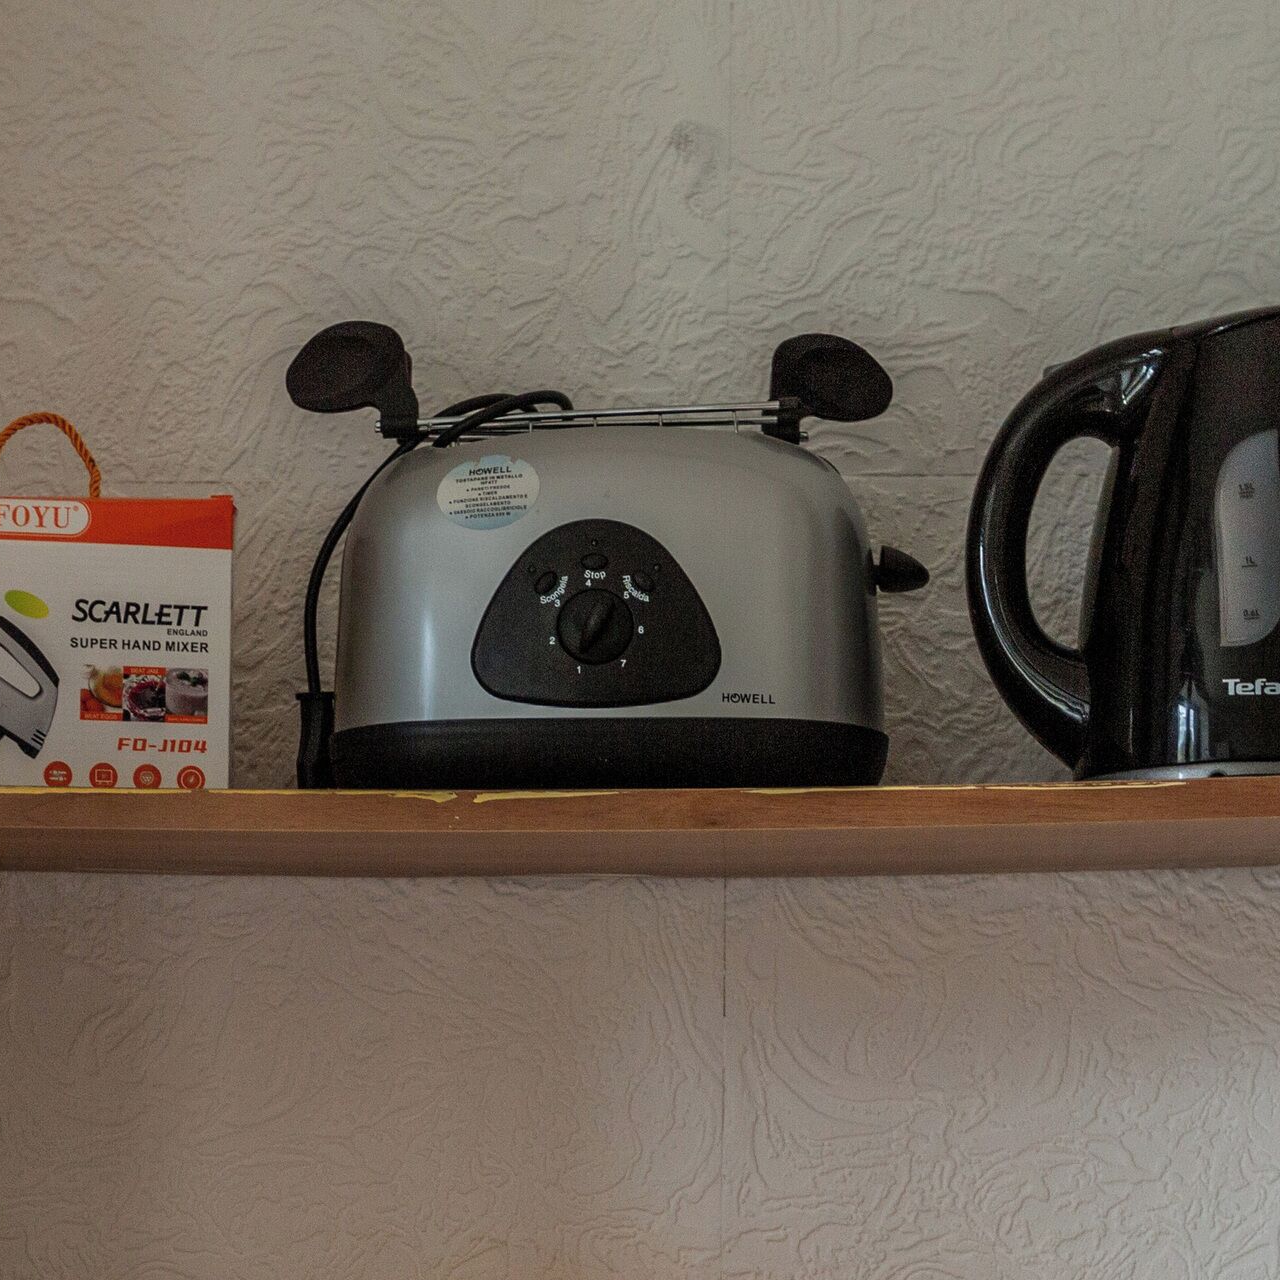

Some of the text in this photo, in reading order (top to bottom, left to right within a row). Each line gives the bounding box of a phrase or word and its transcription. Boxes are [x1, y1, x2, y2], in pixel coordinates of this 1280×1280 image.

[469, 467, 512, 476] HOWELL
[584, 569, 607, 580] Stop
[585, 579, 592, 588] 4
[539, 575, 569, 605] Scongela
[622, 574, 650, 603] Riscalda
[623, 591, 630, 600] 5
[554, 599, 561, 608] 3
[72, 599, 208, 627] SCARLETT
[166, 628, 209, 637] ENGLAND
[638, 626, 644, 634] 6
[70, 637, 210, 653] SUPER HAND MIXER
[549, 636, 556, 645] 2
[620, 659, 627, 668] 7
[722, 693, 775, 704] HOWELL
